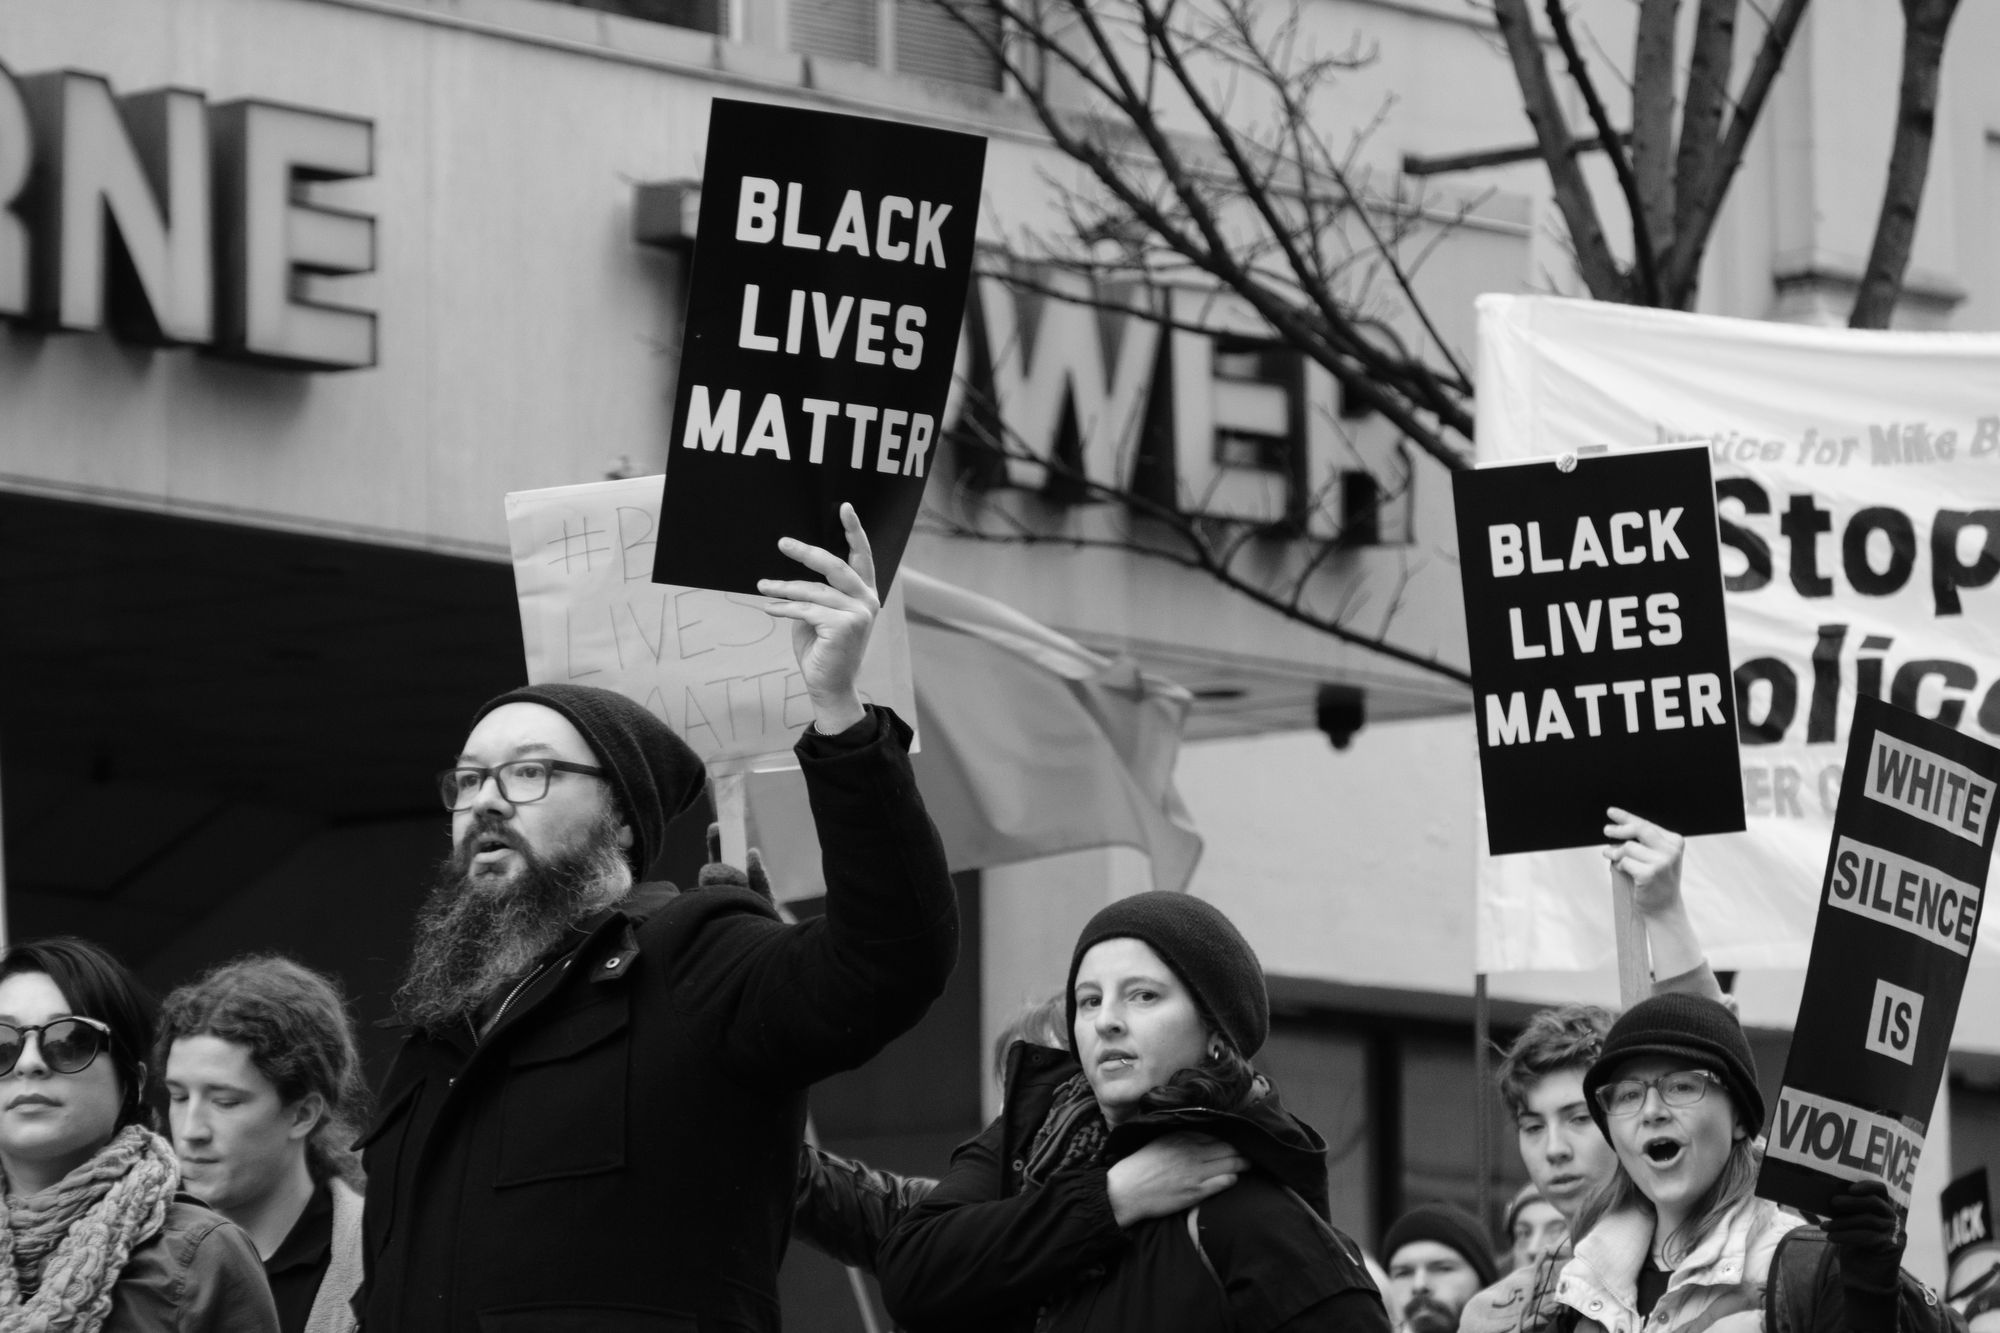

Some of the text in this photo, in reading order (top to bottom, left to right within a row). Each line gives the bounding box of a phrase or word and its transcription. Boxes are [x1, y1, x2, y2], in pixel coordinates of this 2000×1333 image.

[735, 175, 953, 269] BLACK
[738, 283, 927, 371] LIVES
[682, 384, 934, 478] MATTER
[930, 268, 1416, 548] WER
[1796, 428, 1859, 467] for
[1868, 422, 1958, 466] Mike
[1488, 507, 1690, 578] BLACK
[1715, 477, 2000, 618] Stop
[566, 590, 776, 679] LIVES
[1509, 592, 1683, 660] LIVES
[1485, 672, 1726, 747] MATTER
[1875, 743, 1987, 834] WHITE
[1833, 851, 1978, 946] SILENCE
[1878, 995, 1912, 1051] IS
[1779, 1098, 1922, 1192] VIOLENCE
